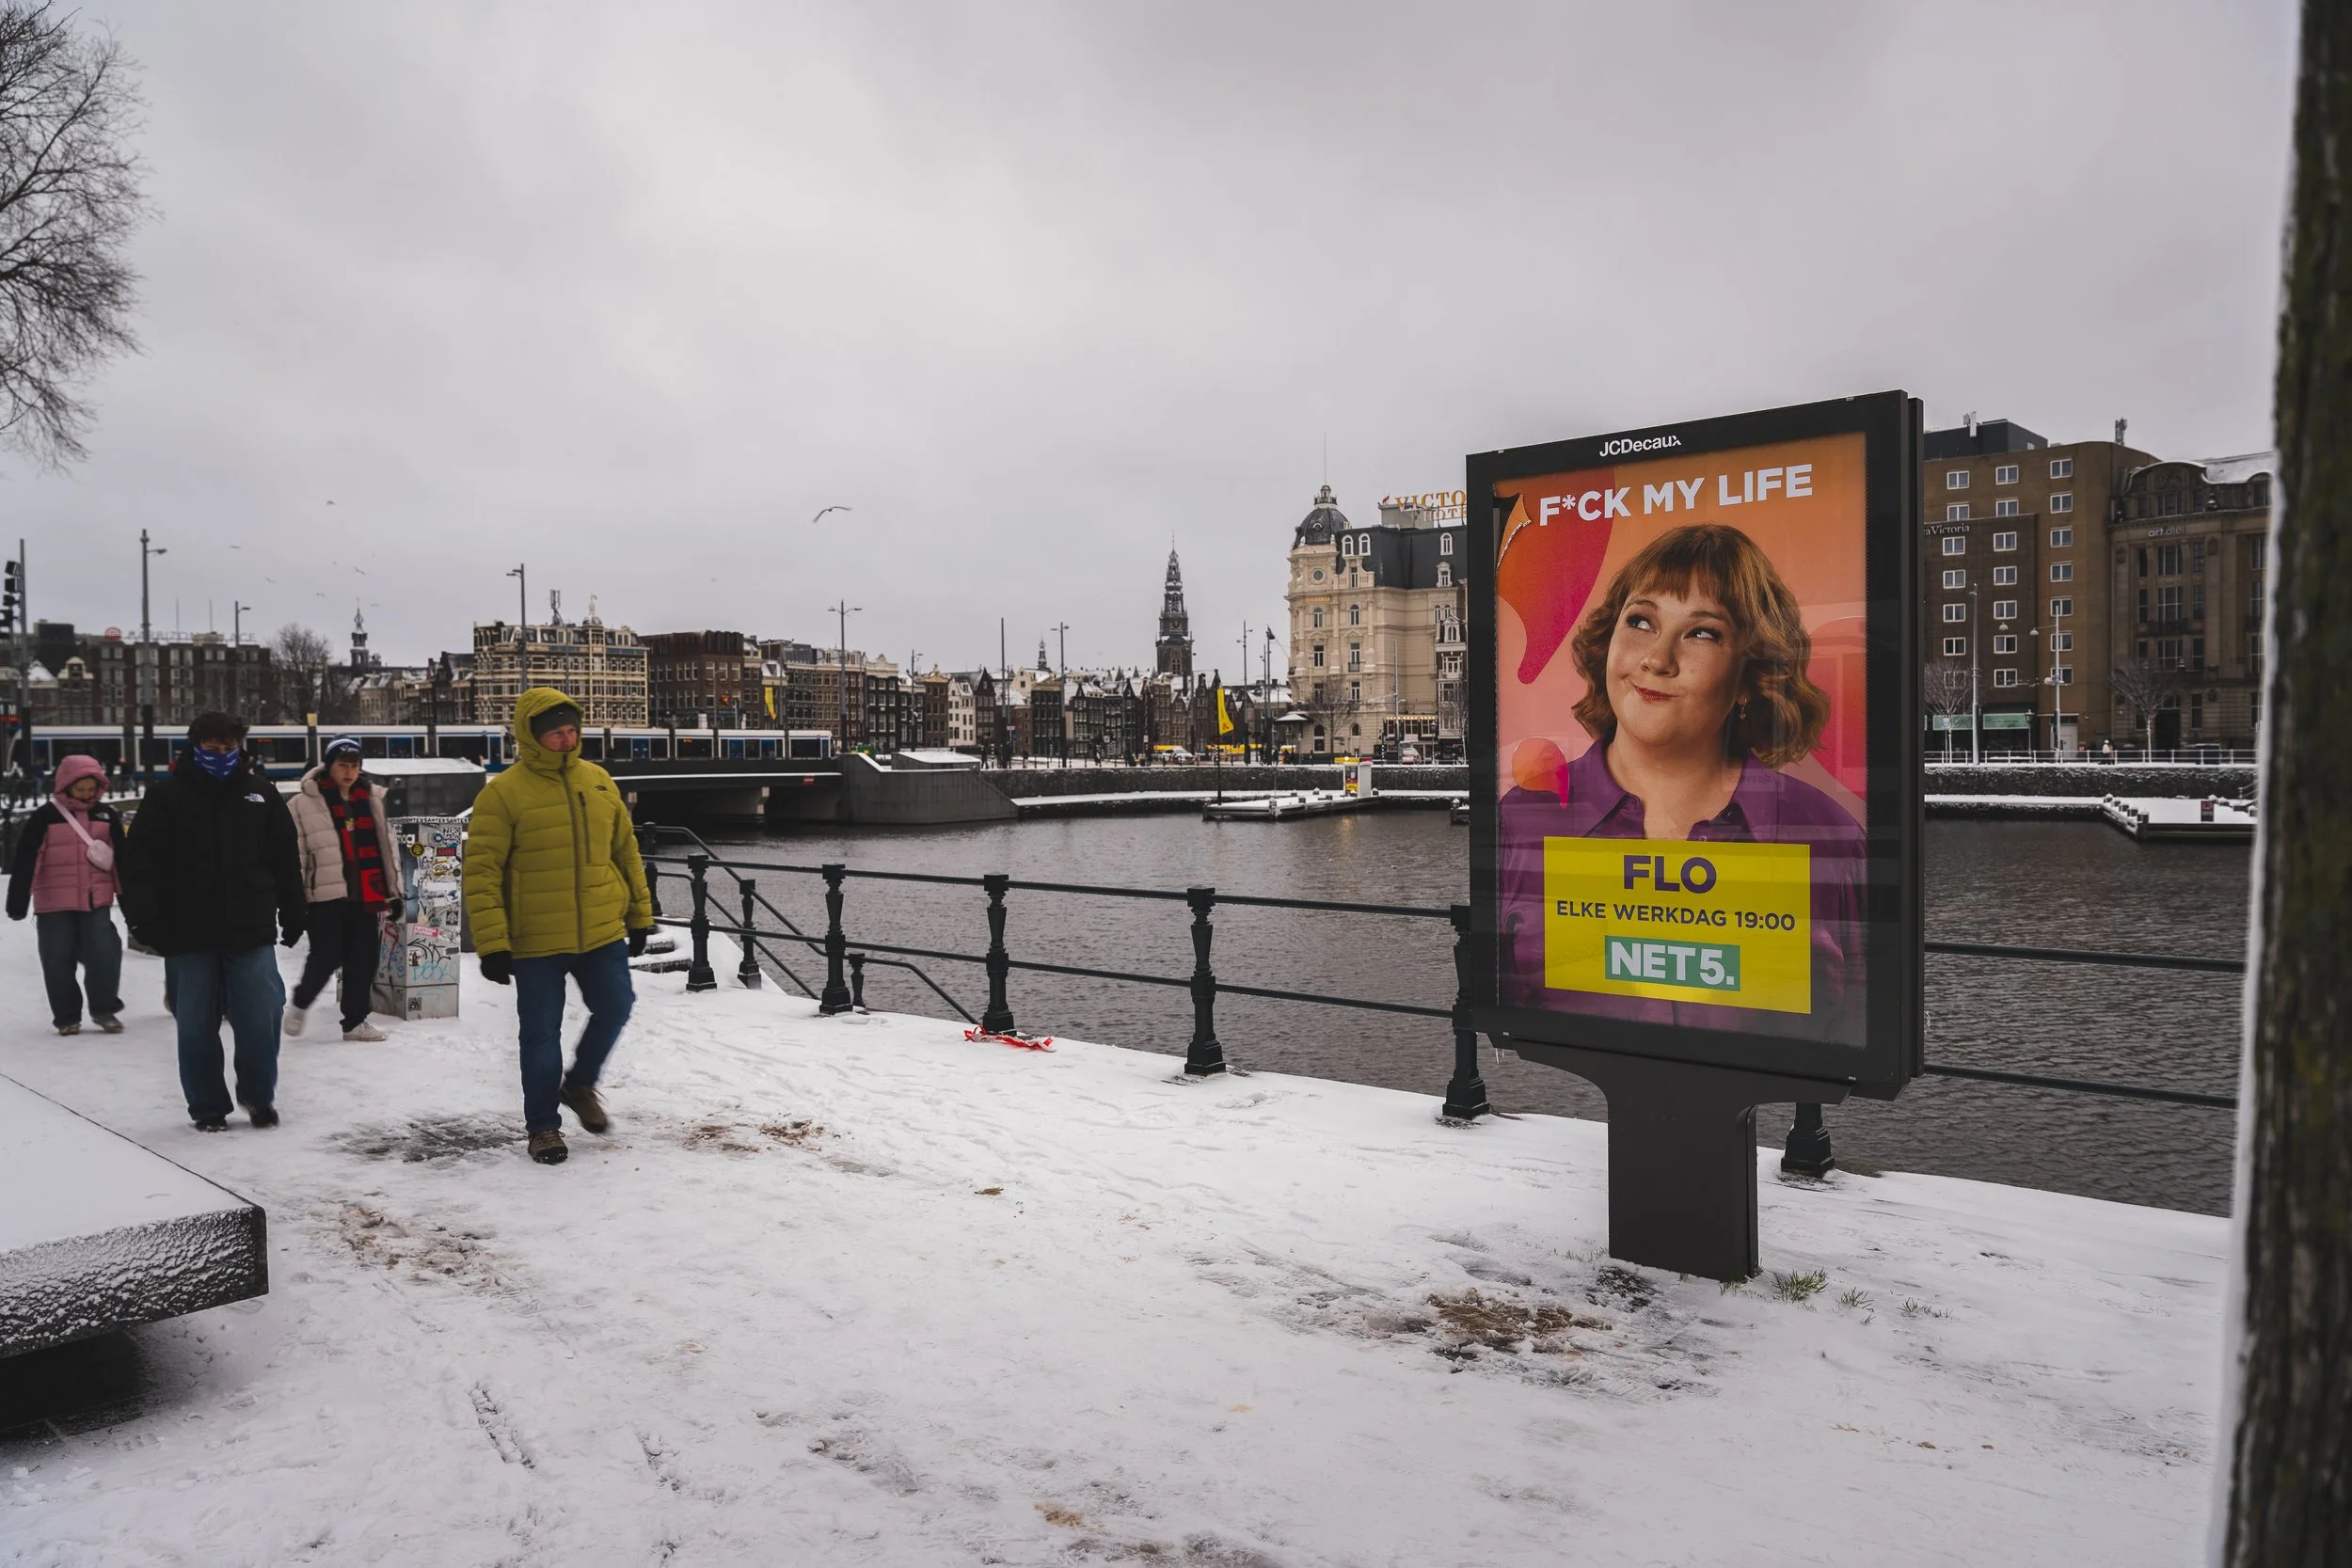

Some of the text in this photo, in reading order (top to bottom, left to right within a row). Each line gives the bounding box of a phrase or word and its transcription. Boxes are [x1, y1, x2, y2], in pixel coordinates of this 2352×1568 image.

[1599, 435, 1681, 457] JCDecaux
[1644, 477, 1705, 515] MY
[1718, 464, 1813, 506] LIFE
[1624, 854, 1717, 894] FLO
[1556, 899, 1795, 931] ELKE WERKDAG 19:00
